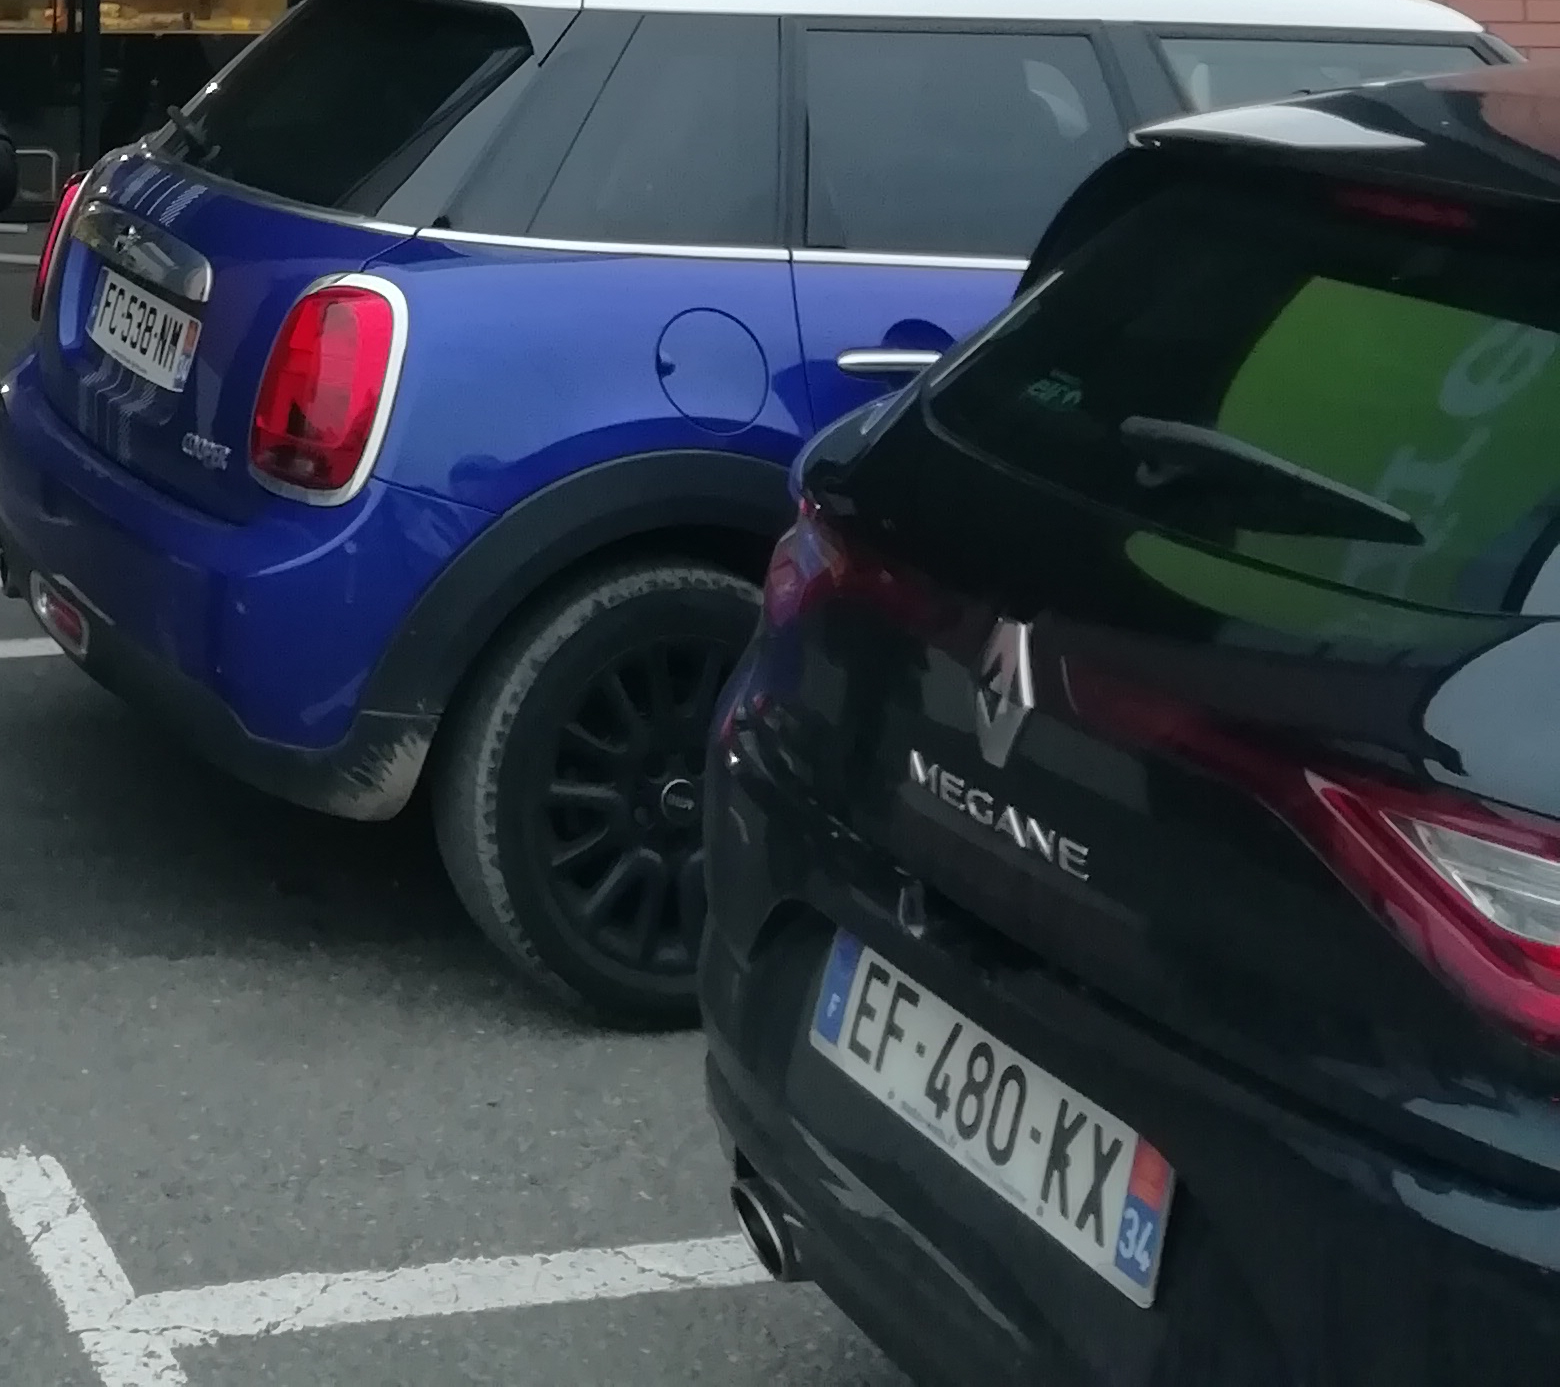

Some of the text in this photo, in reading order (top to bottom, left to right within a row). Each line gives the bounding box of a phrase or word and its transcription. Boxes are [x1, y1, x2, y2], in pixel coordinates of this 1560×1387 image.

[910, 748, 1090, 881] MEGANE
[846, 960, 1124, 1249] EF-480-KX
[1118, 1207, 1155, 1273] 34
